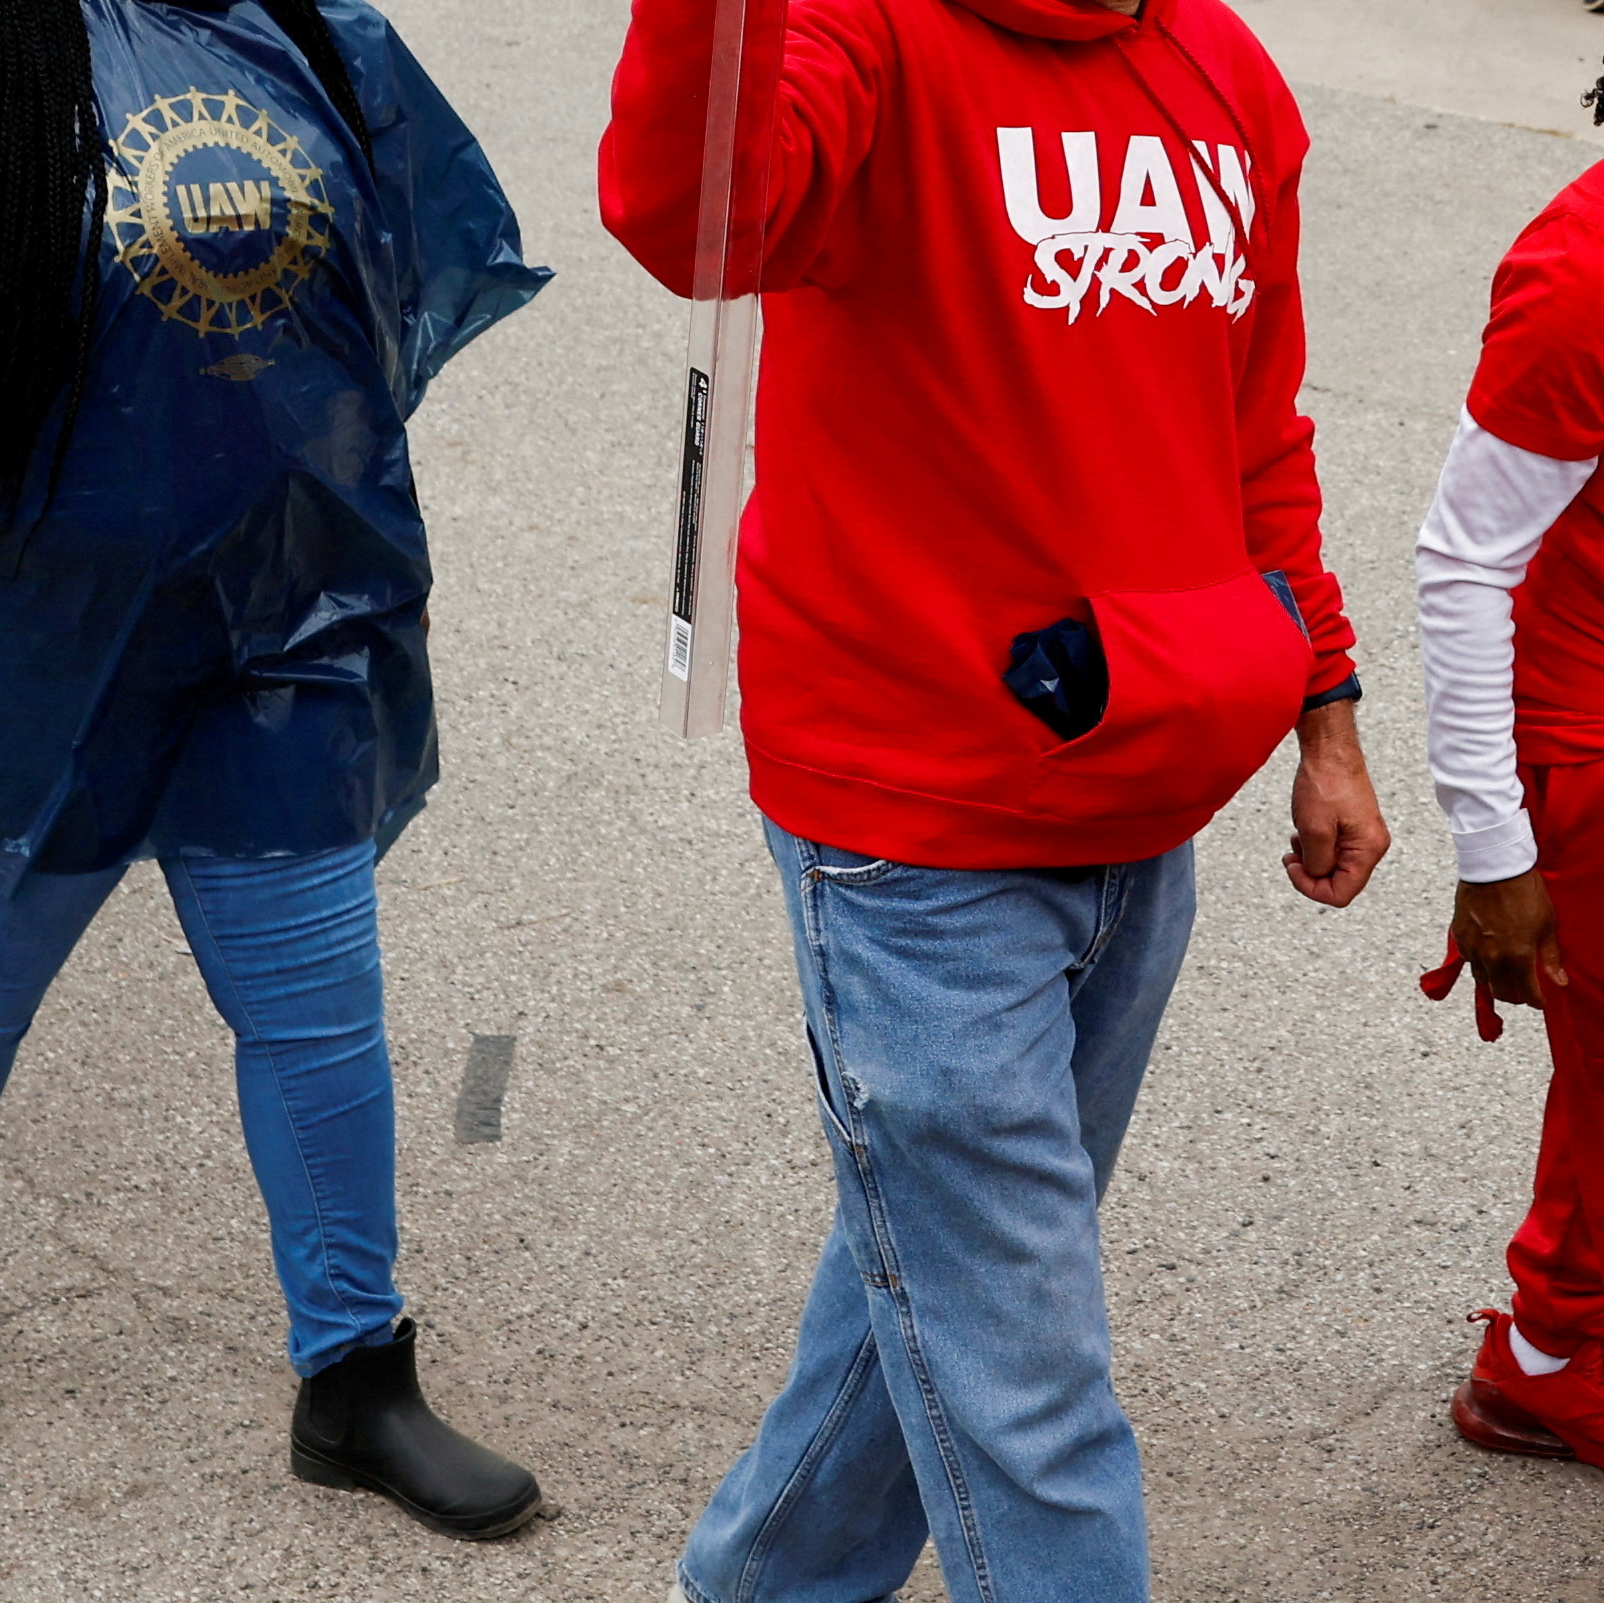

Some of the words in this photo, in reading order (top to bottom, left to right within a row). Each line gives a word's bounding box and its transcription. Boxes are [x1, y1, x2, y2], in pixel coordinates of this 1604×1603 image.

[144, 161, 160, 213] WORKERS
[163, 129, 206, 153] AMERICA
[208, 126, 247, 145] UNITED
[176, 180, 272, 234] UAW
[997, 127, 1255, 253] UAW
[1023, 230, 1256, 325] STRONG
